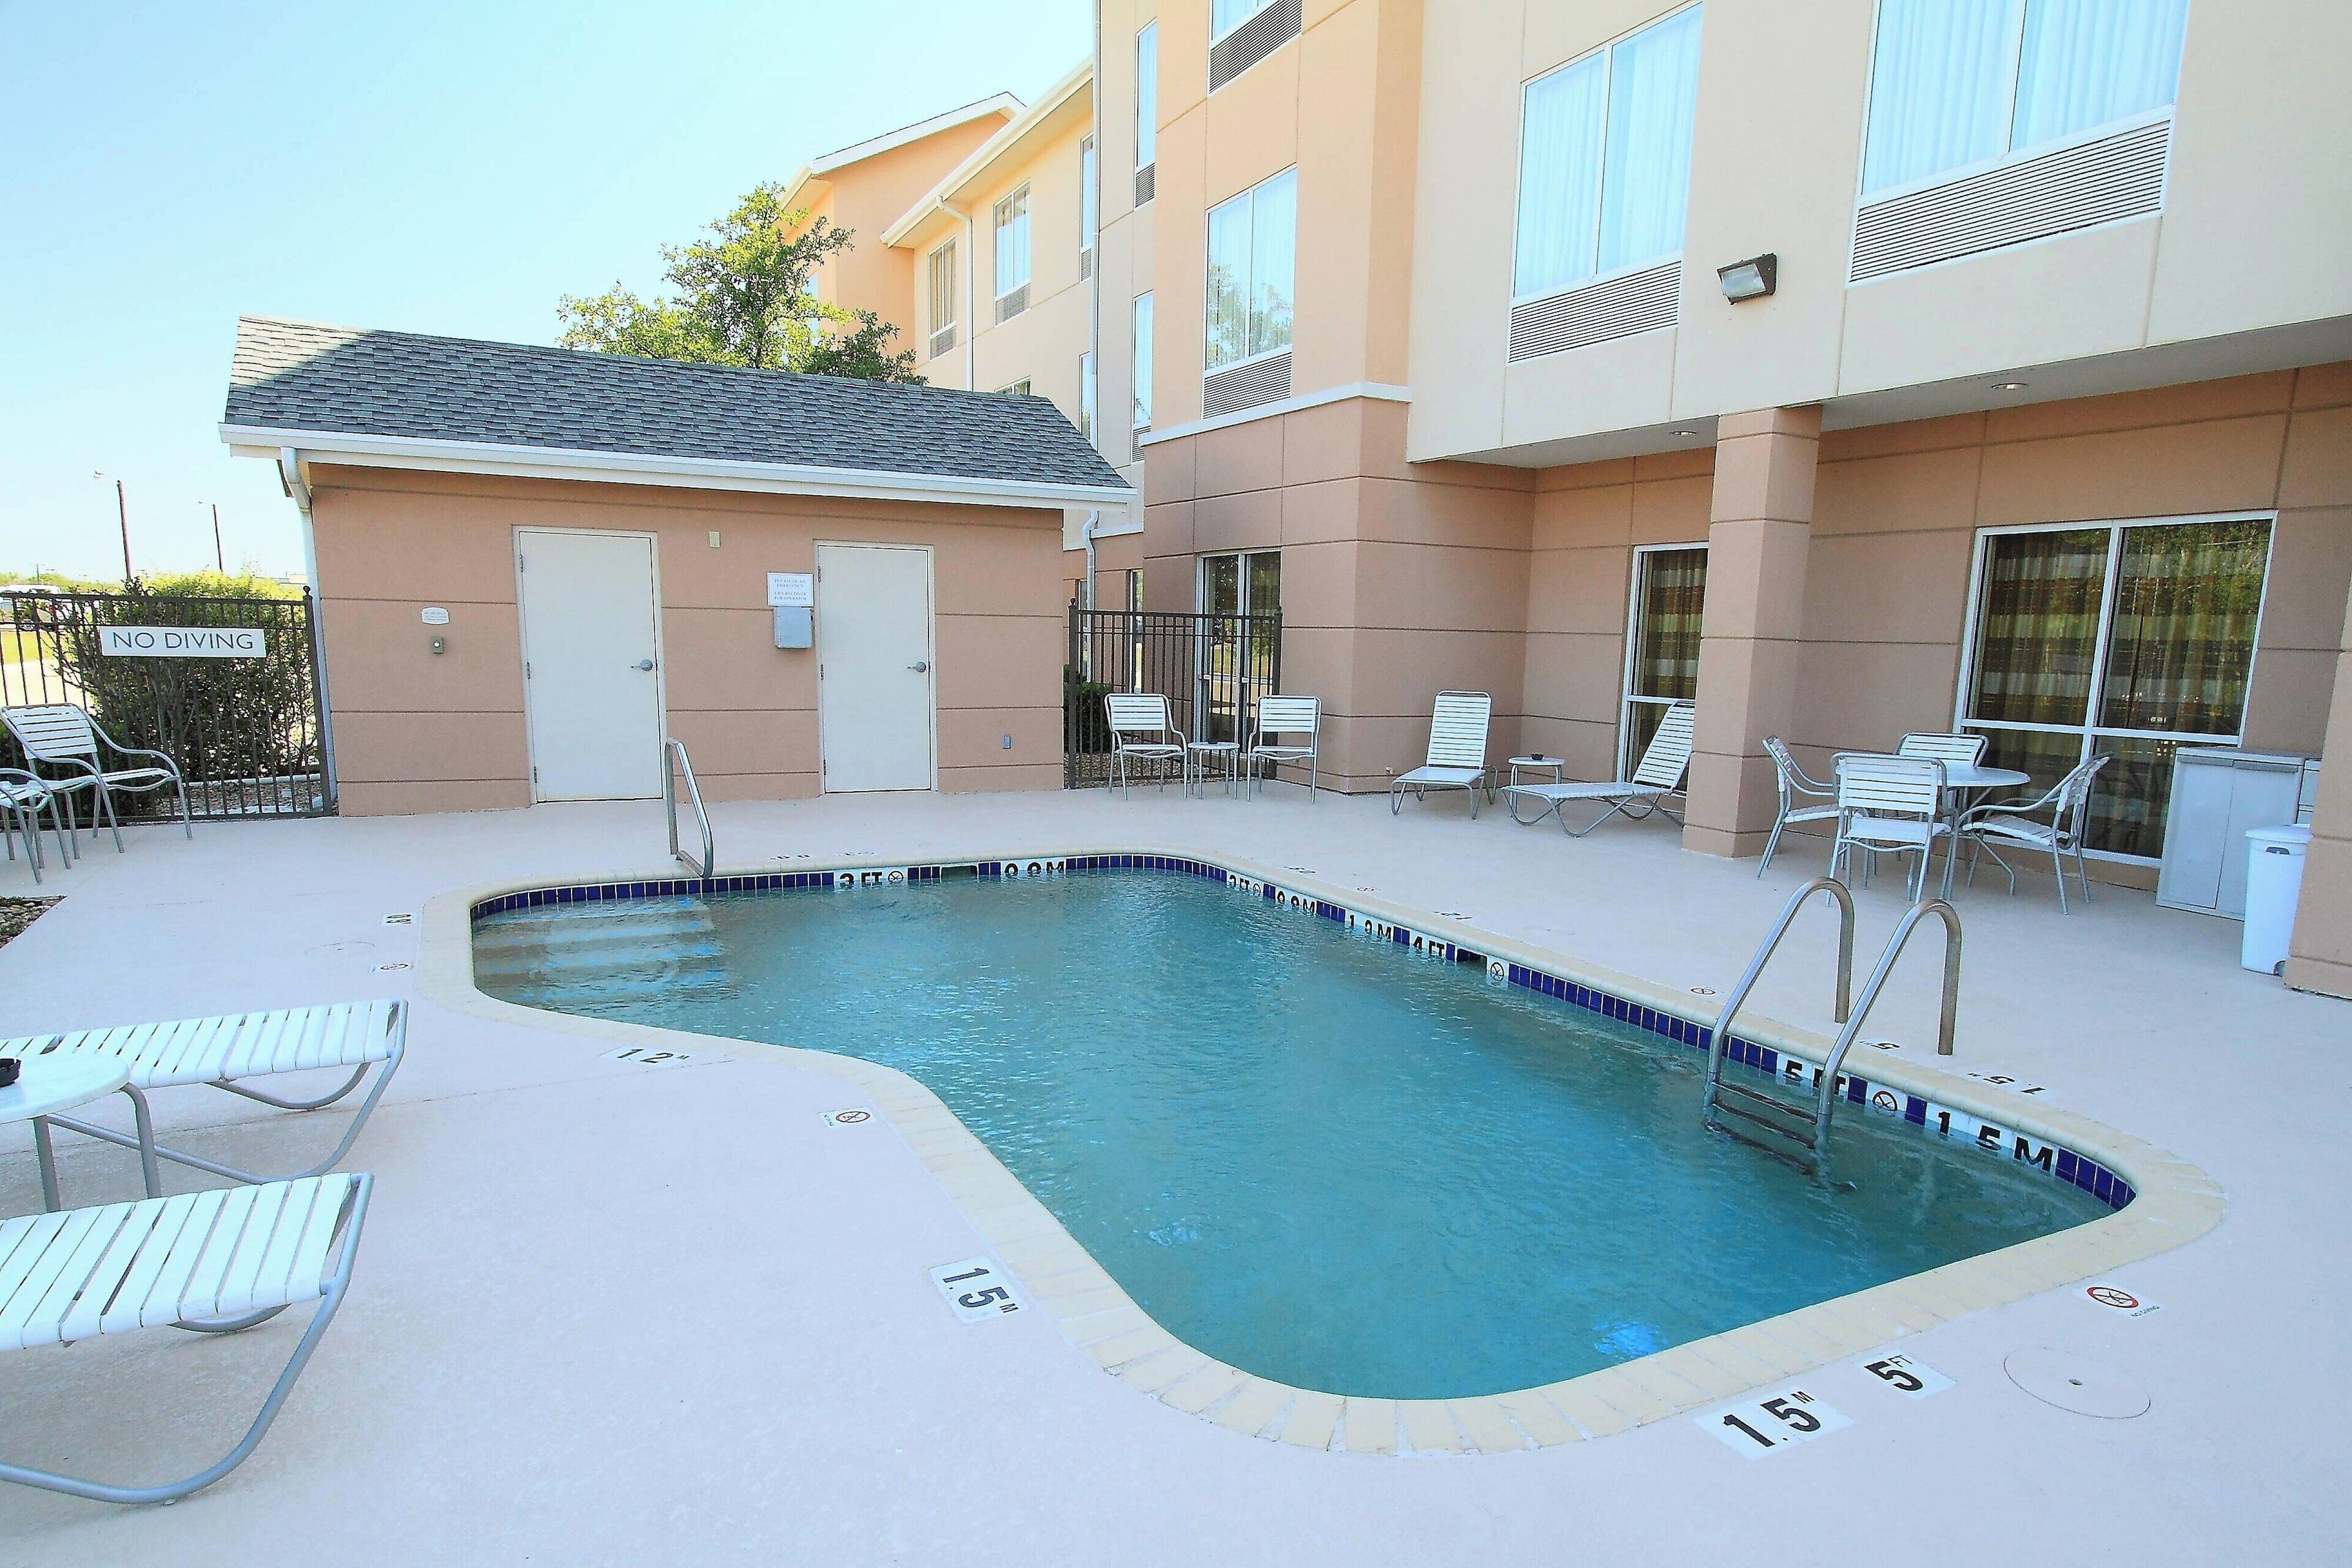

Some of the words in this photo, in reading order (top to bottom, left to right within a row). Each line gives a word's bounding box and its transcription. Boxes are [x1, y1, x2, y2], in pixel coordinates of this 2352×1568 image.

[112, 631, 155, 648] NO
[164, 632, 253, 649] DIVING
[942, 1267, 1009, 1308] 1.5
[1864, 1360, 1923, 1391] 5
[1887, 1354, 1913, 1368] FT
[1723, 1397, 1821, 1447] 1.5
[1790, 1390, 1815, 1404] M
